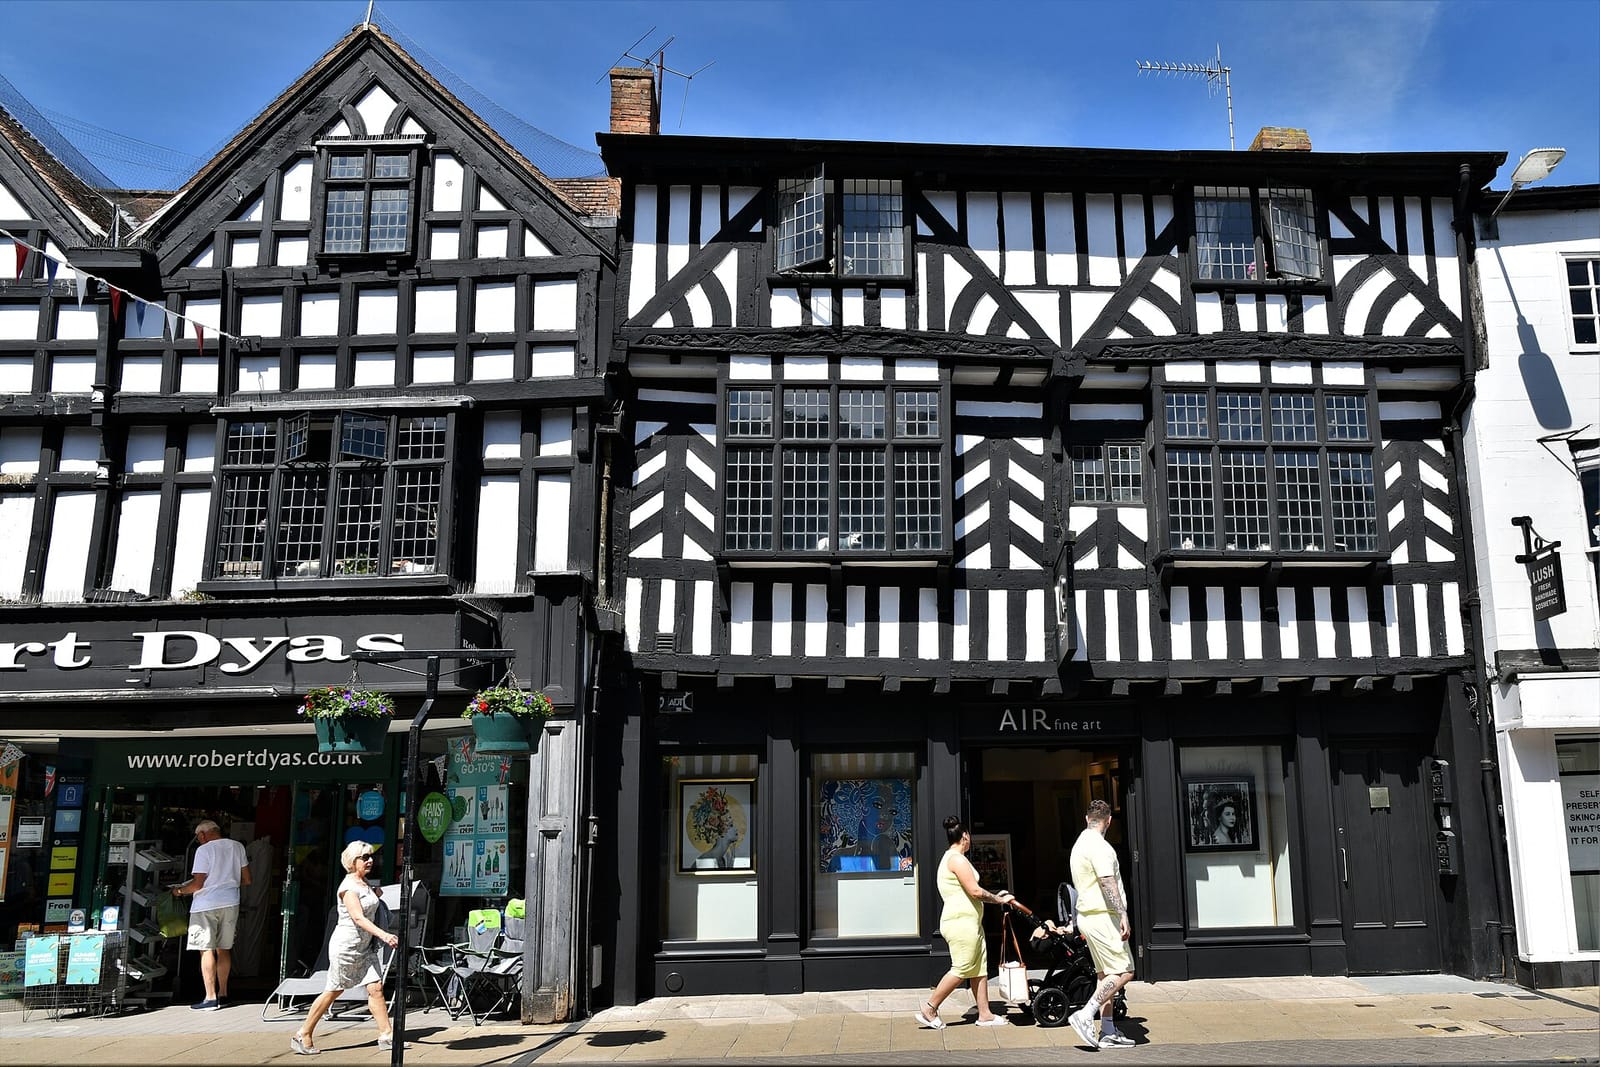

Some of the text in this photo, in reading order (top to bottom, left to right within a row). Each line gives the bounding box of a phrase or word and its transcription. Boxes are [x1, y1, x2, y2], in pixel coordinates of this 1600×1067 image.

[1532, 564, 1554, 584] LUSH
[1538, 582, 1551, 592] FRESH
[1535, 597, 1558, 611] COSMETICS
[128, 631, 404, 673] Dyas
[999, 708, 1102, 731] AIR fine art
[127, 748, 363, 771] www.robertdyas.co.uk
[461, 761, 496, 775] GO-TO'S
[1580, 790, 1600, 798] SELF
[424, 801, 444, 818] FANS
[1571, 836, 1599, 845] IT FOR
[48, 902, 70, 910] Free
